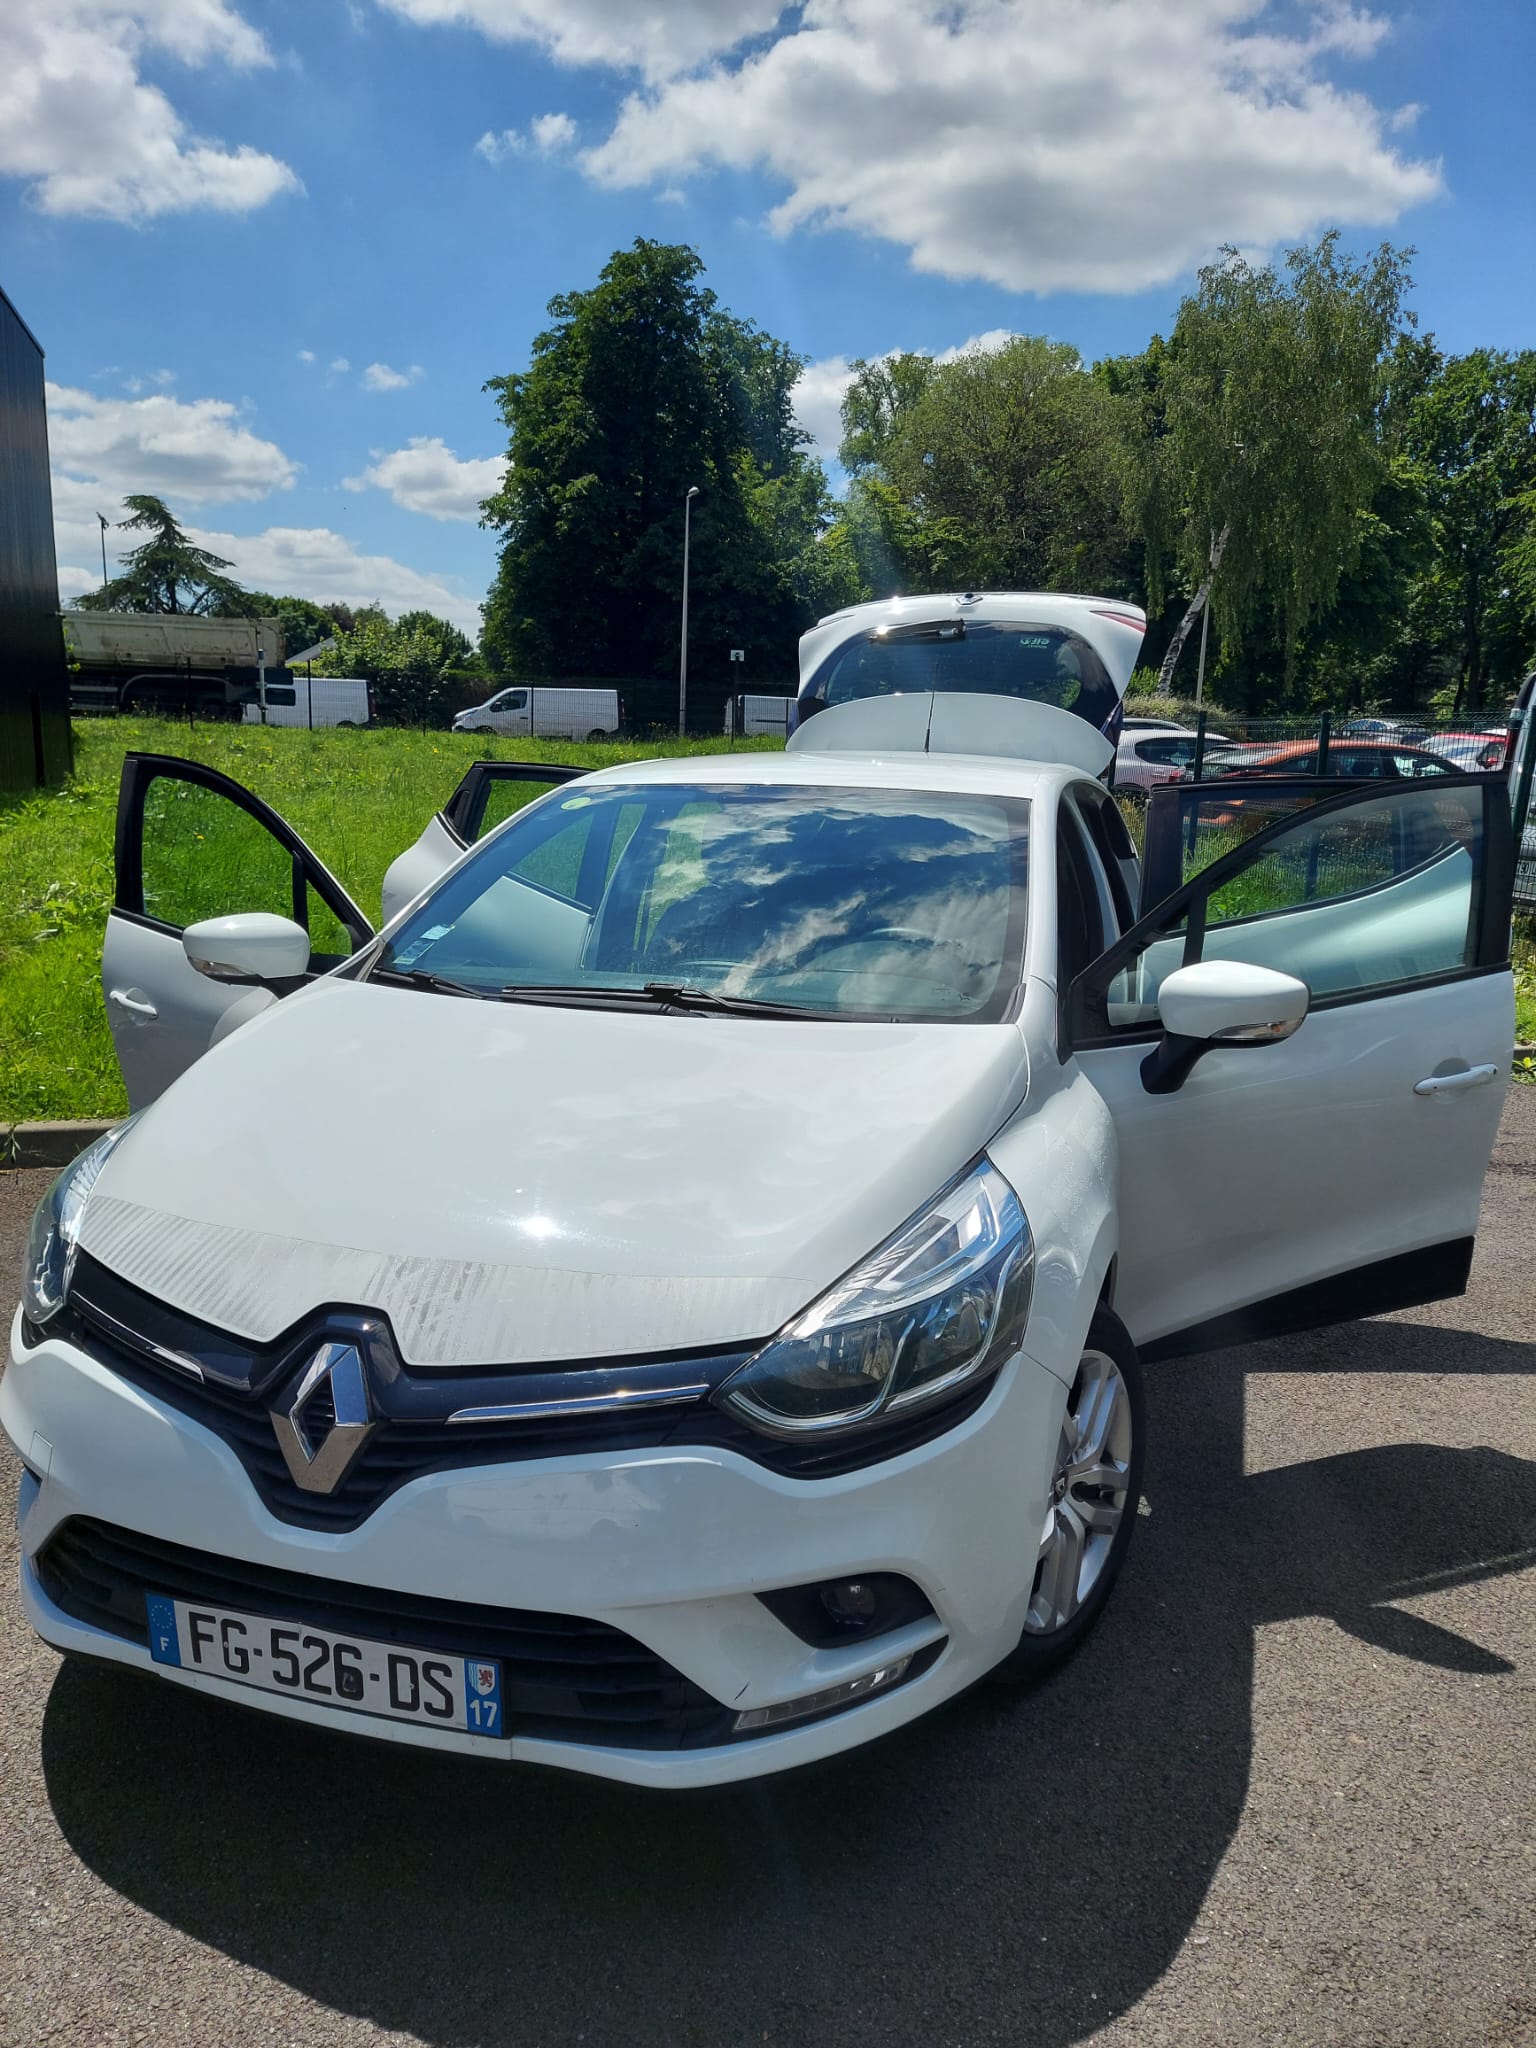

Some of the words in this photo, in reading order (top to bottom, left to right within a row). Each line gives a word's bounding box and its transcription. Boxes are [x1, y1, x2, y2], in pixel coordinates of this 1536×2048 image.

[160, 1636, 169, 1651] F
[188, 1611, 454, 1719] FG-526-DS
[469, 1699, 498, 1728] 17
